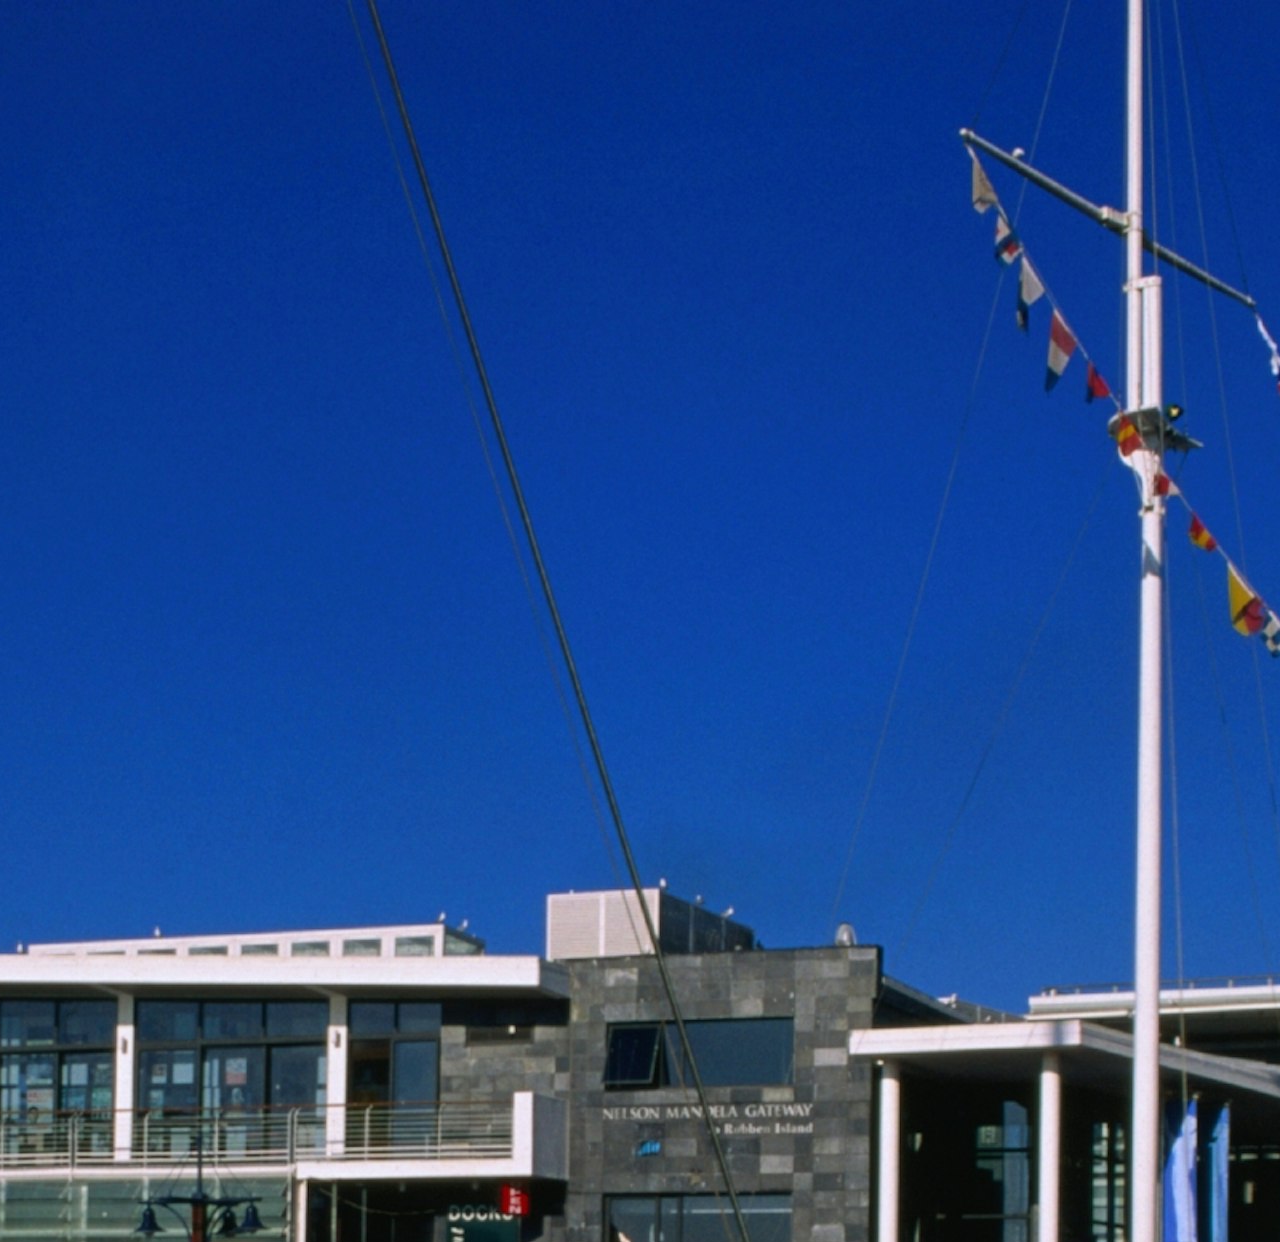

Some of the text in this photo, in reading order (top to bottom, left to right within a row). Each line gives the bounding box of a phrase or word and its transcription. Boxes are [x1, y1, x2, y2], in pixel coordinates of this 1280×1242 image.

[602, 1107, 660, 1120] NELSON
[744, 1103, 813, 1117] GATEWAY
[724, 1122, 770, 1135] Robben
[775, 1122, 813, 1134] Island
